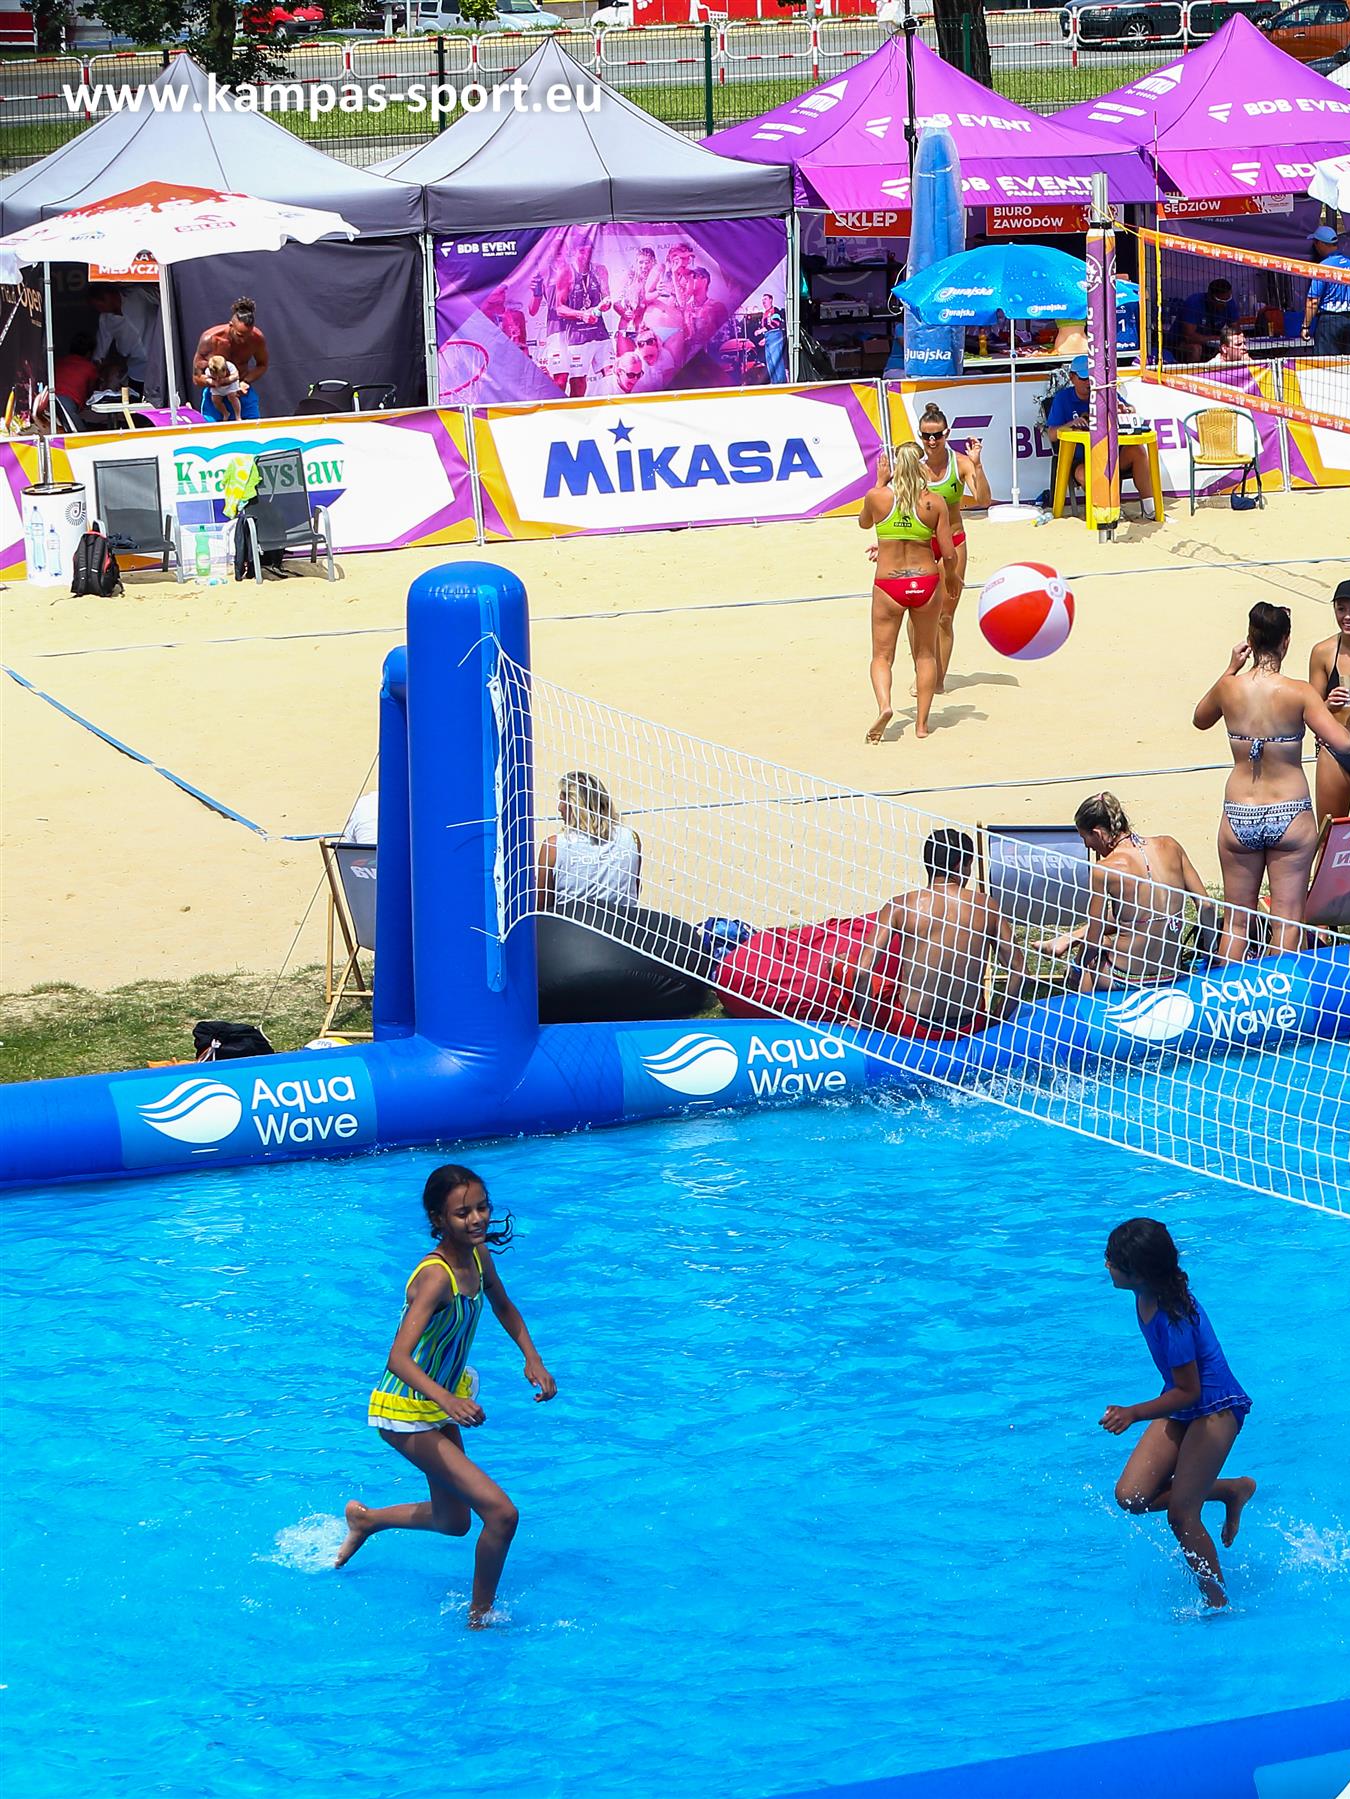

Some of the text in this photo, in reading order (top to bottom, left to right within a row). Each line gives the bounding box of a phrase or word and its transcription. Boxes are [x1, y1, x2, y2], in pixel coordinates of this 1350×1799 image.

[1242, 98, 1292, 117] BDB
[956, 112, 1032, 133] EVENT
[996, 175, 1093, 191] EVENT
[993, 206, 1032, 217] BIURO
[1163, 200, 1221, 215] SĘDZIÓW
[835, 211, 898, 228] SKLEP
[993, 215, 1064, 230] ZAWODÓW
[456, 241, 517, 254] BDB EVENT
[946, 286, 995, 298] Jurajska
[945, 308, 976, 319] Jurajska
[1118, 318, 1126, 333] 1
[1201, 972, 1292, 1008] Aqua
[1205, 1004, 1297, 1039] Wave
[747, 1030, 847, 1067] Aqua
[749, 1066, 847, 1097] Wave
[251, 1075, 355, 1110] Aqua
[253, 1113, 358, 1146] Wave
